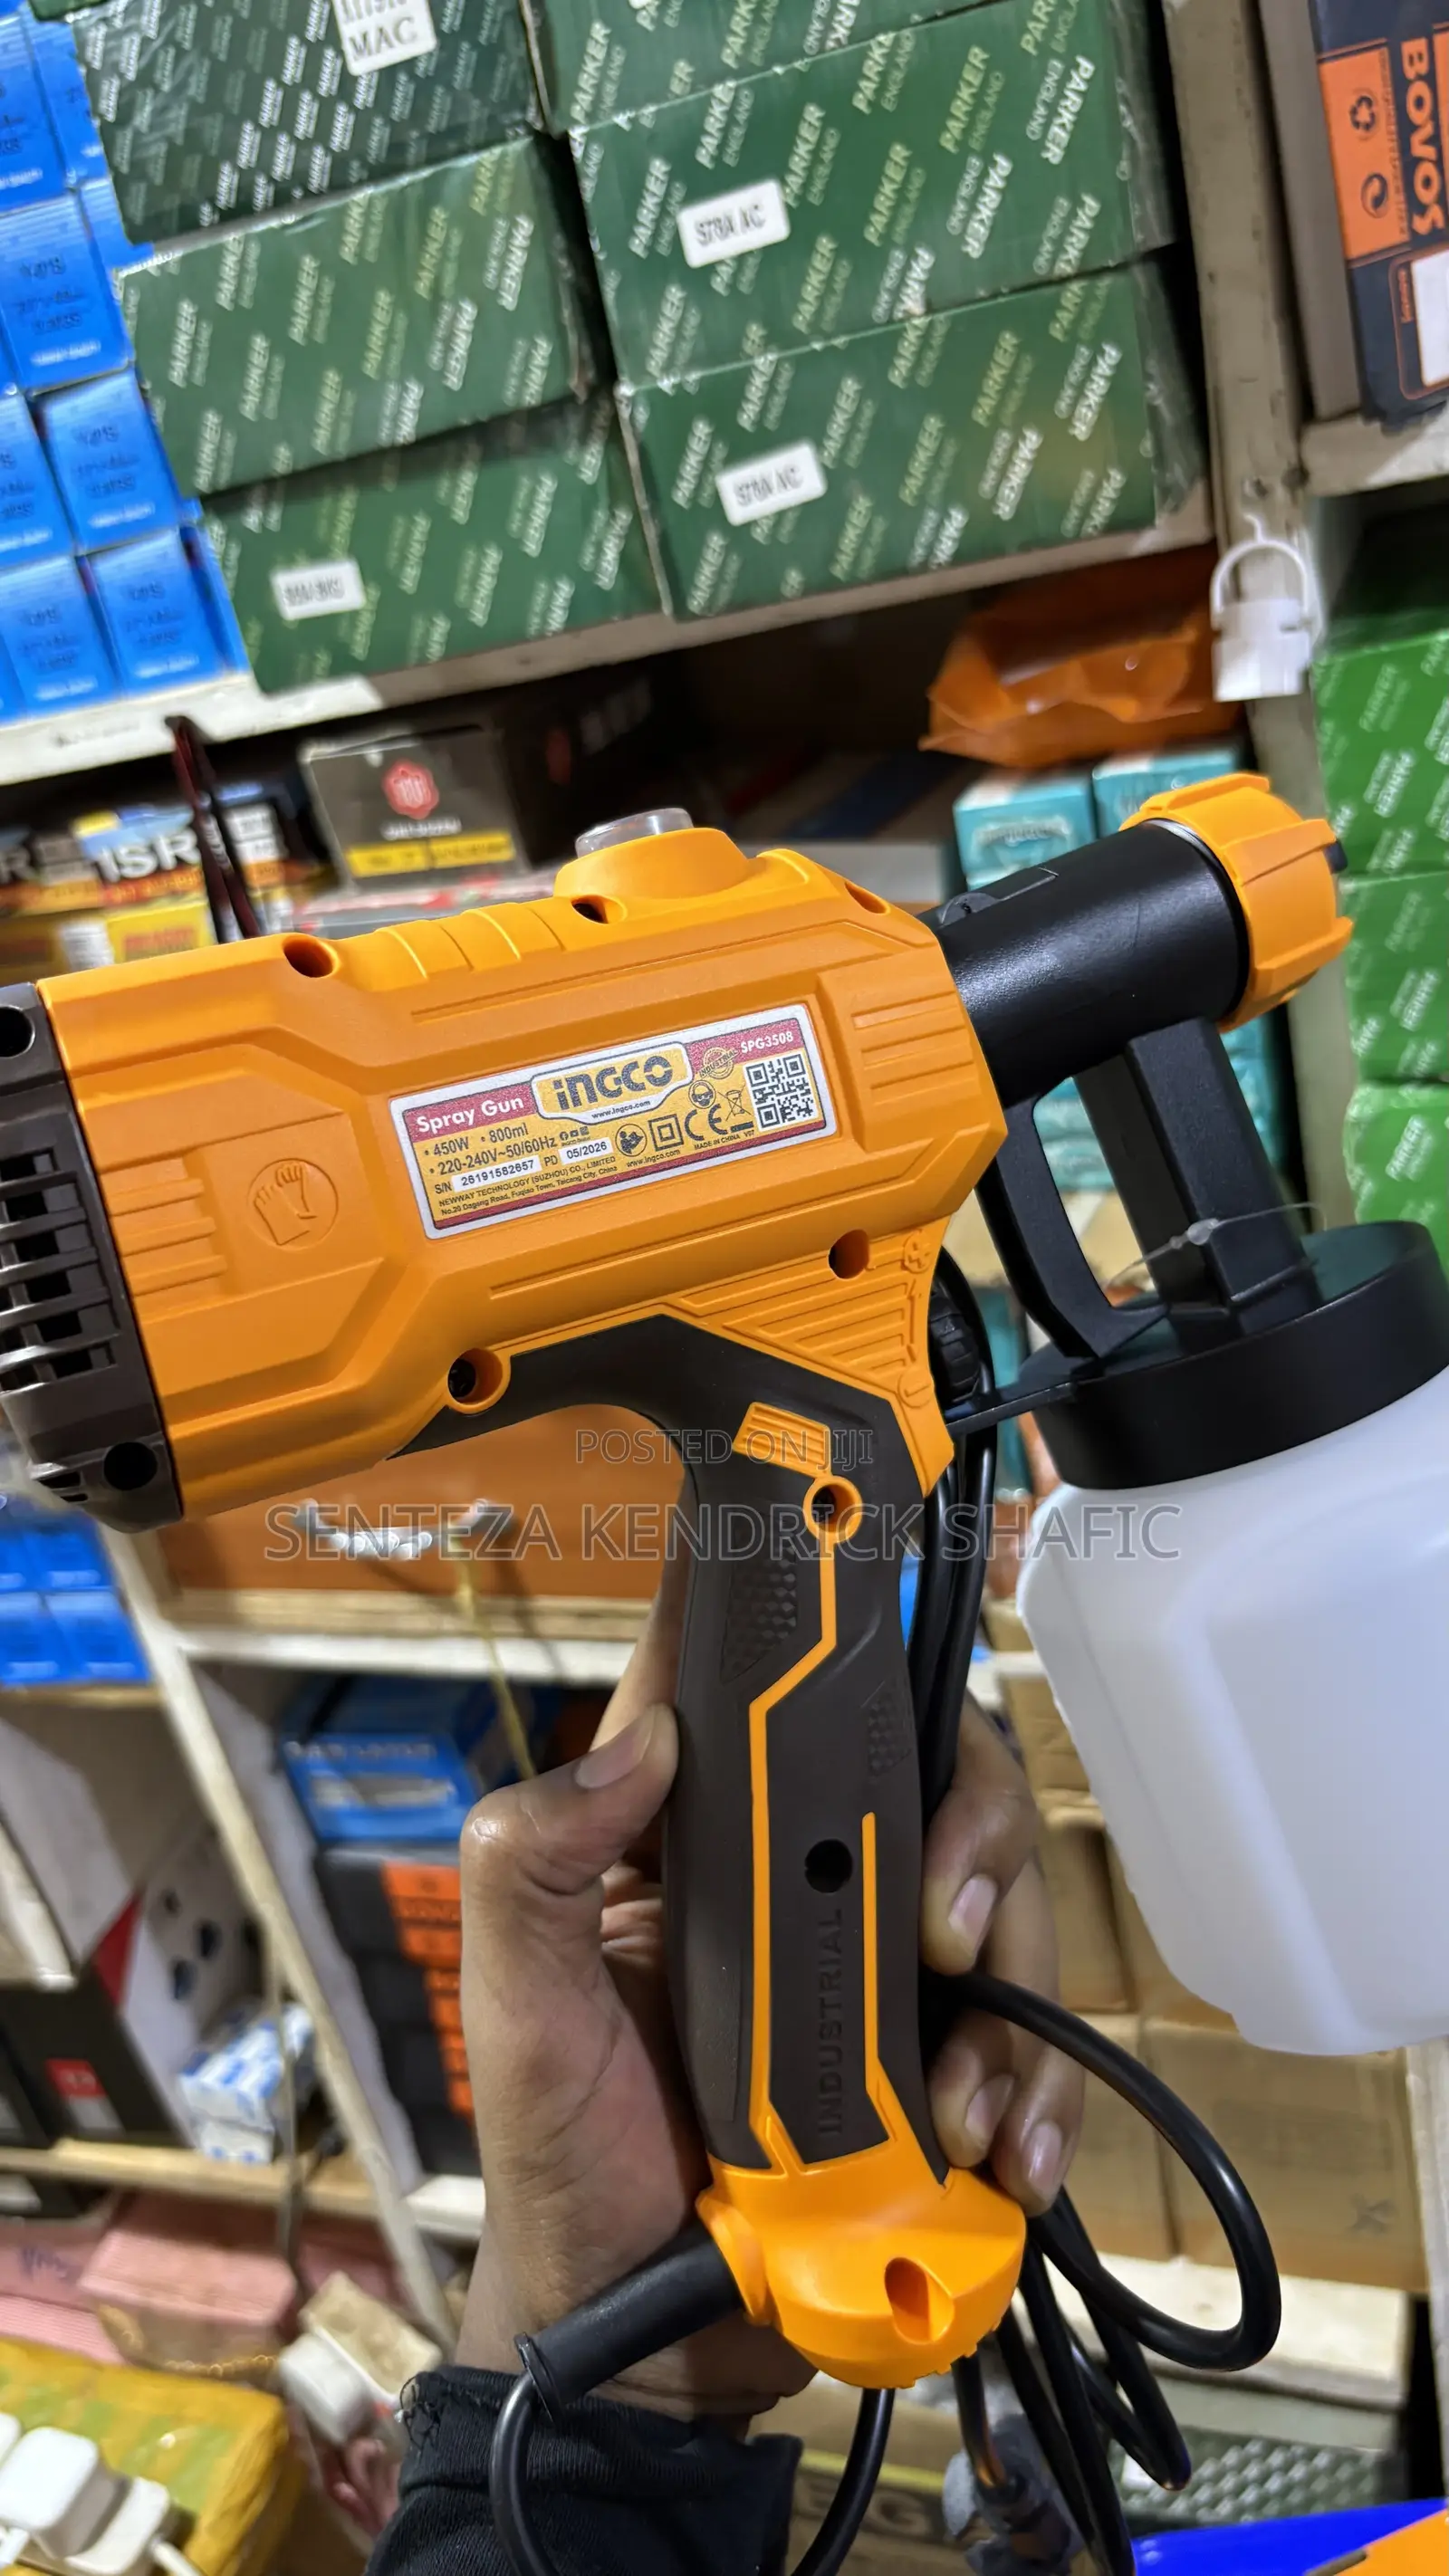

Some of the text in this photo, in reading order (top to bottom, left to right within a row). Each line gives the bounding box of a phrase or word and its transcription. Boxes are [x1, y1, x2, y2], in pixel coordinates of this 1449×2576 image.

[349, 15, 417, 62] MAC
[570, 20, 612, 125] PARKER
[721, 0, 755, 69] PARK
[696, 80, 736, 169] PARKE
[939, 44, 991, 154] PARKER
[1025, 58, 1064, 140] ENGLAND
[1041, 54, 1096, 165] PARKER
[1401, 37, 1445, 235] BOVOS
[784, 102, 826, 208] PARKER
[863, 141, 912, 247] PARKER
[629, 157, 671, 259] PARKER
[961, 152, 1013, 259] PARKER
[1053, 193, 1101, 275] PARKE
[496, 214, 534, 311] PARKER
[792, 234, 838, 334] PARKER
[442, 295, 478, 391] PARKER
[972, 329, 1022, 426] PARKER
[820, 374, 862, 469] PARKER
[1068, 341, 1122, 441] PARKER
[671, 415, 714, 510] PARKER
[899, 412, 945, 506] PARKER
[993, 423, 1043, 521] PARKER
[700, 1049, 737, 1077] INDUSTRIAL
[740, 1030, 793, 1053] SPG3508
[416, 1096, 524, 1134] Spray Gun
[434, 1122, 529, 1156] 450W 800ml
[437, 1135, 558, 1175] 220-240V~50/60Hz
[626, 1149, 681, 1169] www.ingco.com
[694, 1139, 713, 1151] MADE
[721, 1134, 741, 1144] CHINA
[435, 1182, 452, 1194] S/N
[543, 1154, 558, 1166] PD
[566, 1141, 608, 1160] 05/2026
[438, 1192, 475, 1207] NEWWAY
[475, 1177, 530, 1196] TECHNOLOGY
[532, 1169, 569, 1183] (SUZHOU)
[586, 1156, 616, 1169] LIMITED
[819, 1908, 843, 2135] INDUSTRIAL
